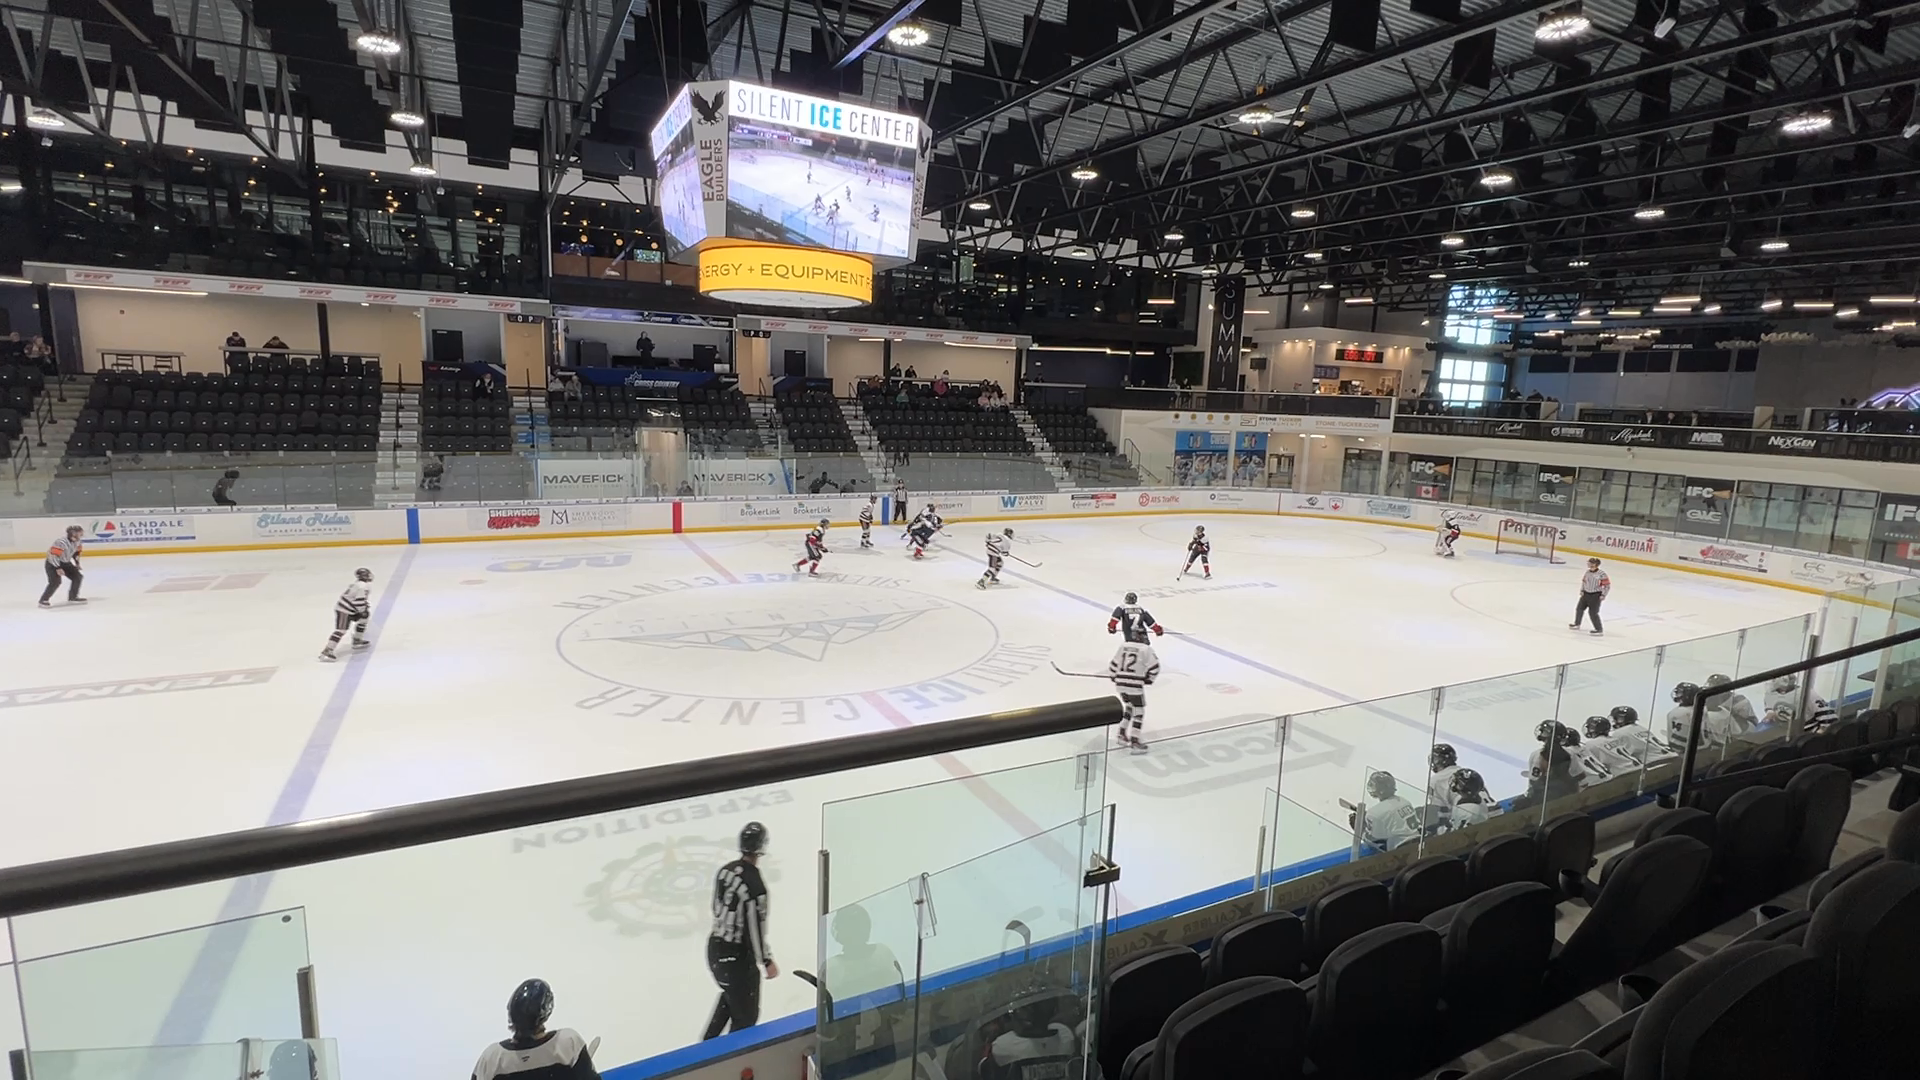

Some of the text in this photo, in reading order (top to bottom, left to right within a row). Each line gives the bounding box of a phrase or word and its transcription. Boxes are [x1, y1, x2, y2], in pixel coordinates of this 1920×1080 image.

[737, 88, 803, 122] SILENT
[810, 102, 842, 130] ICE
[849, 111, 915, 143] CENTER
[700, 139, 715, 202] EAGLE
[713, 138, 724, 201] BUILDERS
[701, 263, 743, 281] NERGY
[761, 263, 864, 287] EQUIPMENT
[1216, 279, 1236, 391] SUMMI
[1411, 460, 1436, 474] IFC
[1539, 472, 1561, 483] IFC
[1150, 496, 1180, 504] ATS Traffic
[1686, 485, 1715, 499] IFC
[488, 508, 539, 518] SHERWOOD
[740, 507, 781, 517] BrokerLink
[793, 505, 832, 515] BrokerLink
[119, 519, 185, 529] LANDALE
[120, 526, 163, 537] SIGNS
[1605, 536, 1655, 553] CANADIAN
[1129, 613, 1141, 631] 7
[1120, 652, 1138, 673] 12
[575, 686, 862, 727] CENTER
[512, 789, 796, 854] EXPEDITION
